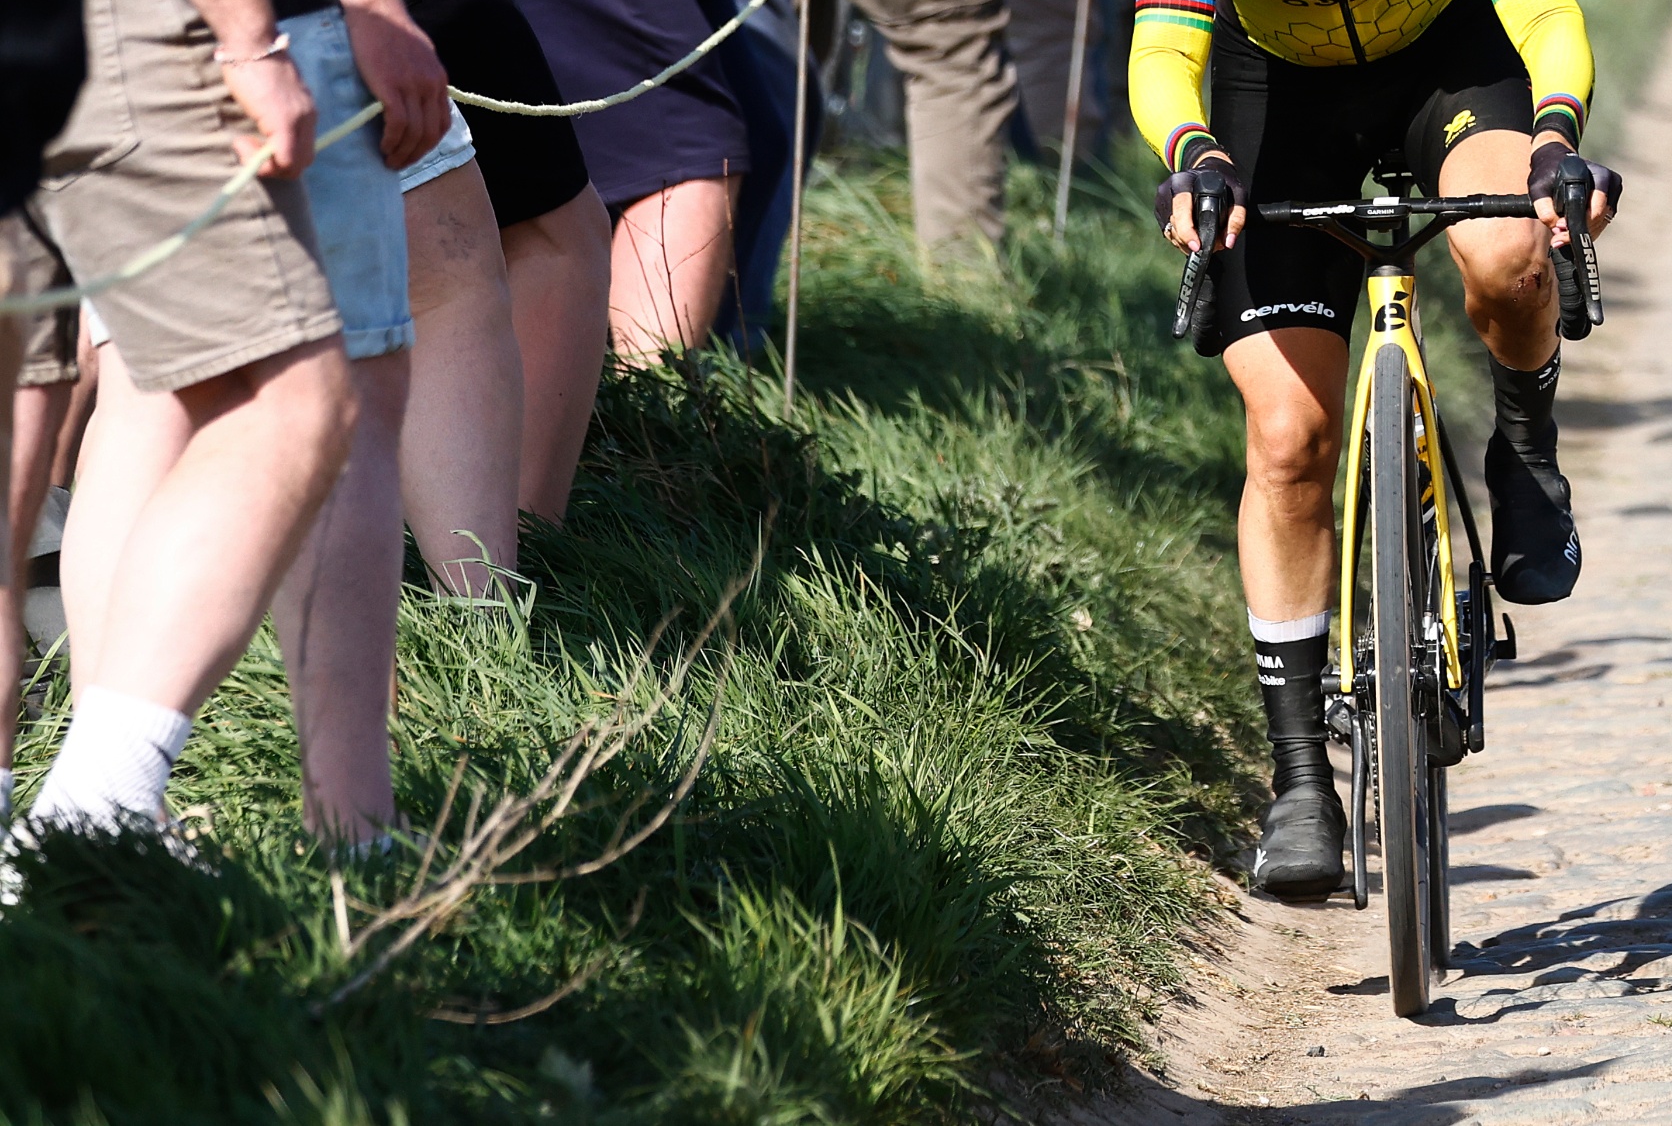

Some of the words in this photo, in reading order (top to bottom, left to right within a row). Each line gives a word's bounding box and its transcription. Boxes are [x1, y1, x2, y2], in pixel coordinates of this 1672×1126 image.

[1366, 208, 1396, 216] GARMIN
[1579, 233, 1601, 302] SRAM
[1240, 300, 1336, 323] cervélo
